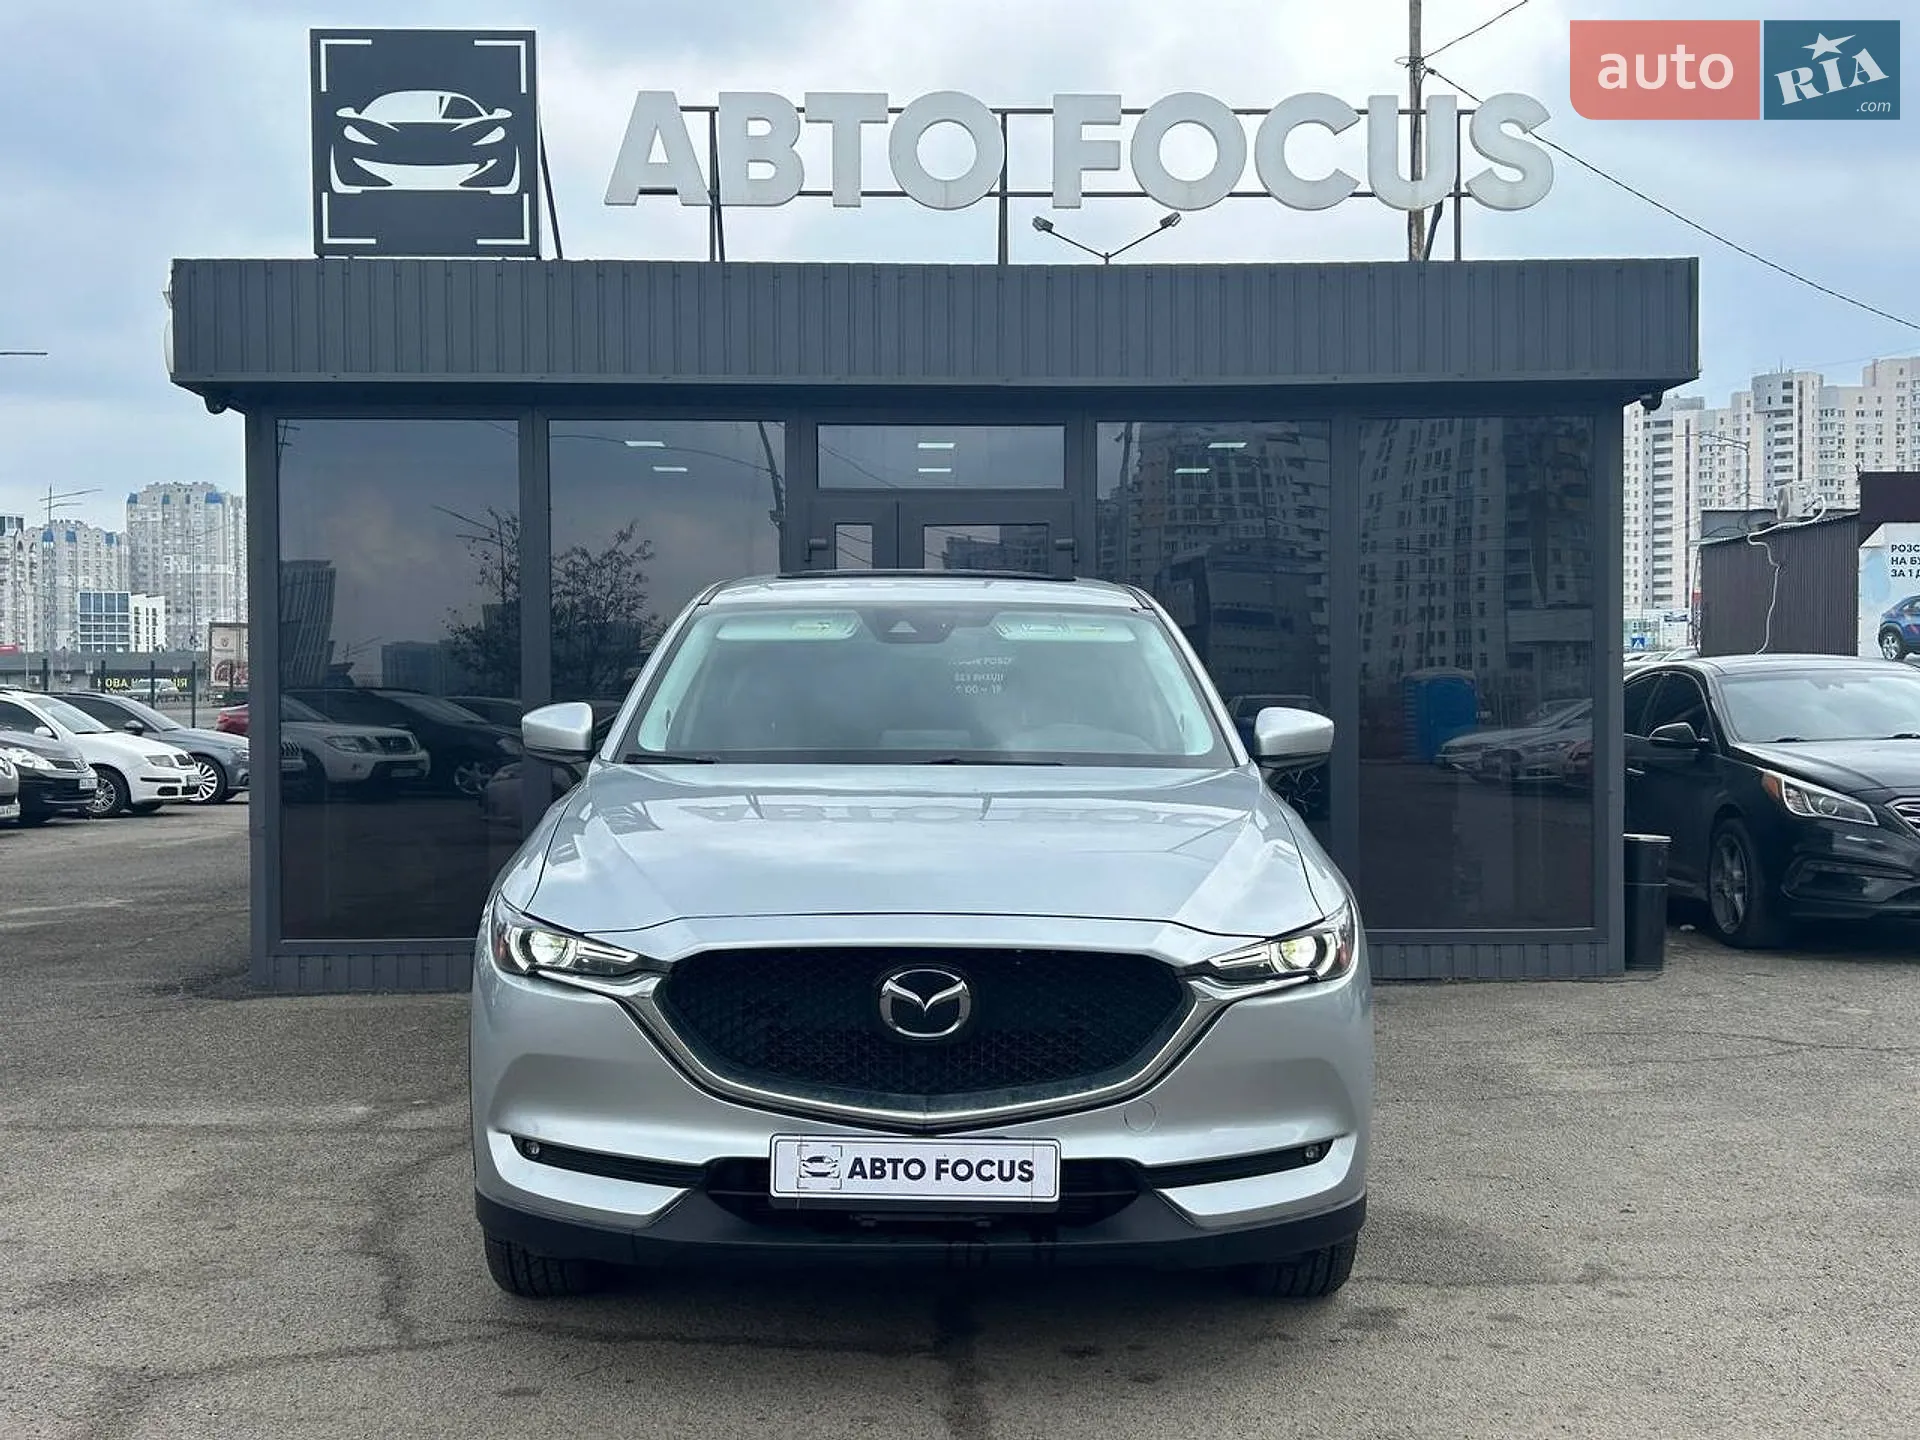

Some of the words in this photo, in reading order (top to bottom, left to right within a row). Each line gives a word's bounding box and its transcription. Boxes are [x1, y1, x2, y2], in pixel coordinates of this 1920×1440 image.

[604, 91, 1006, 210] АВТО
[1052, 92, 1554, 211] FOCUS
[1891, 557, 1907, 565] НА
[1891, 569, 1905, 577] ЗА
[848, 1157, 926, 1181] АВТО
[934, 1158, 1034, 1183] FOCUS
